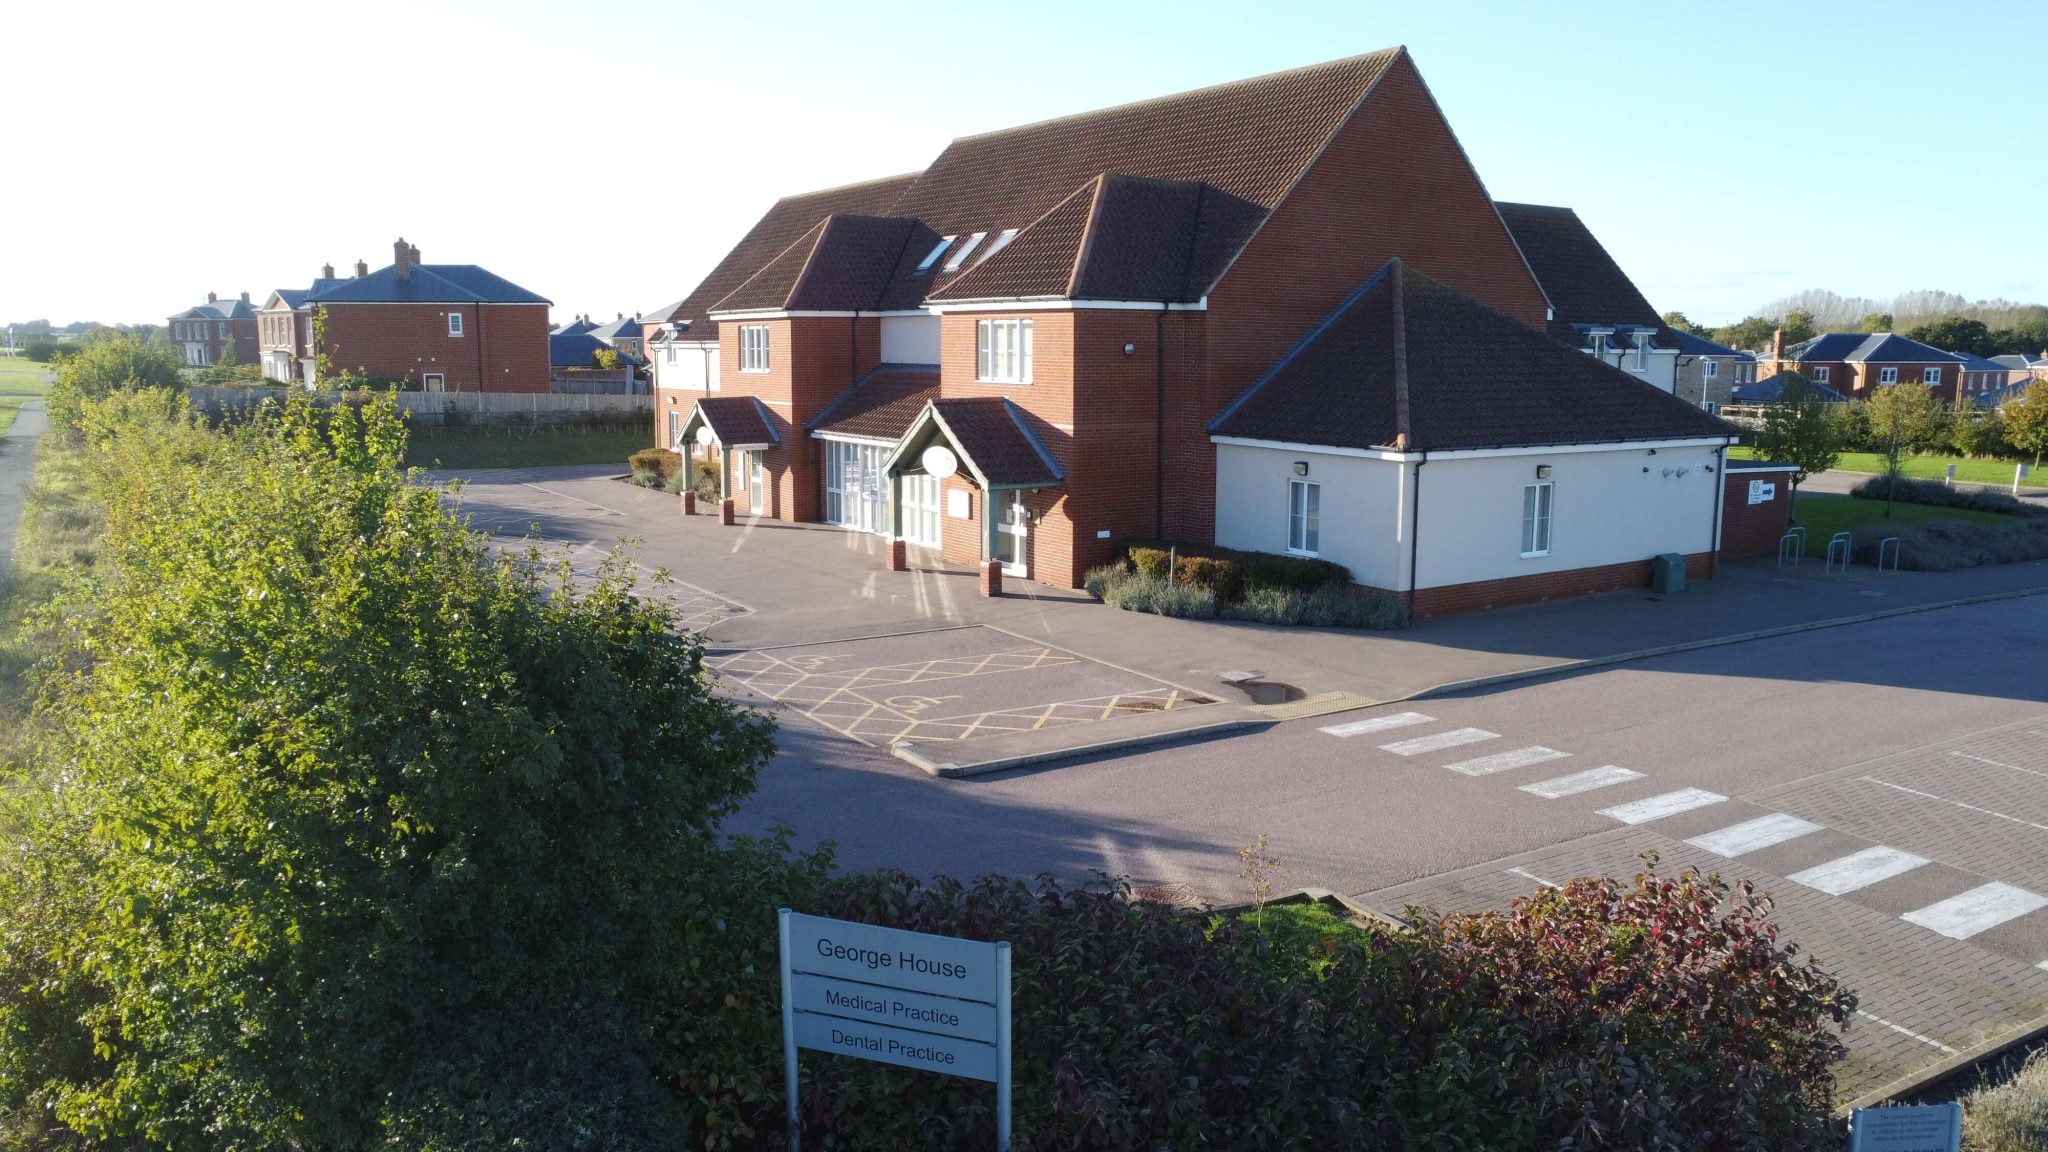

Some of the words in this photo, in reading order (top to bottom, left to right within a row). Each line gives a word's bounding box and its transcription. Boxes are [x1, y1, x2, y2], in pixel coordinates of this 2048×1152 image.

[817, 939, 892, 969] George
[900, 952, 966, 979] House
[826, 990, 887, 1014] Medical
[893, 1002, 959, 1026] Practice
[832, 1029, 882, 1052] Dental
[888, 1041, 954, 1065] Practice
